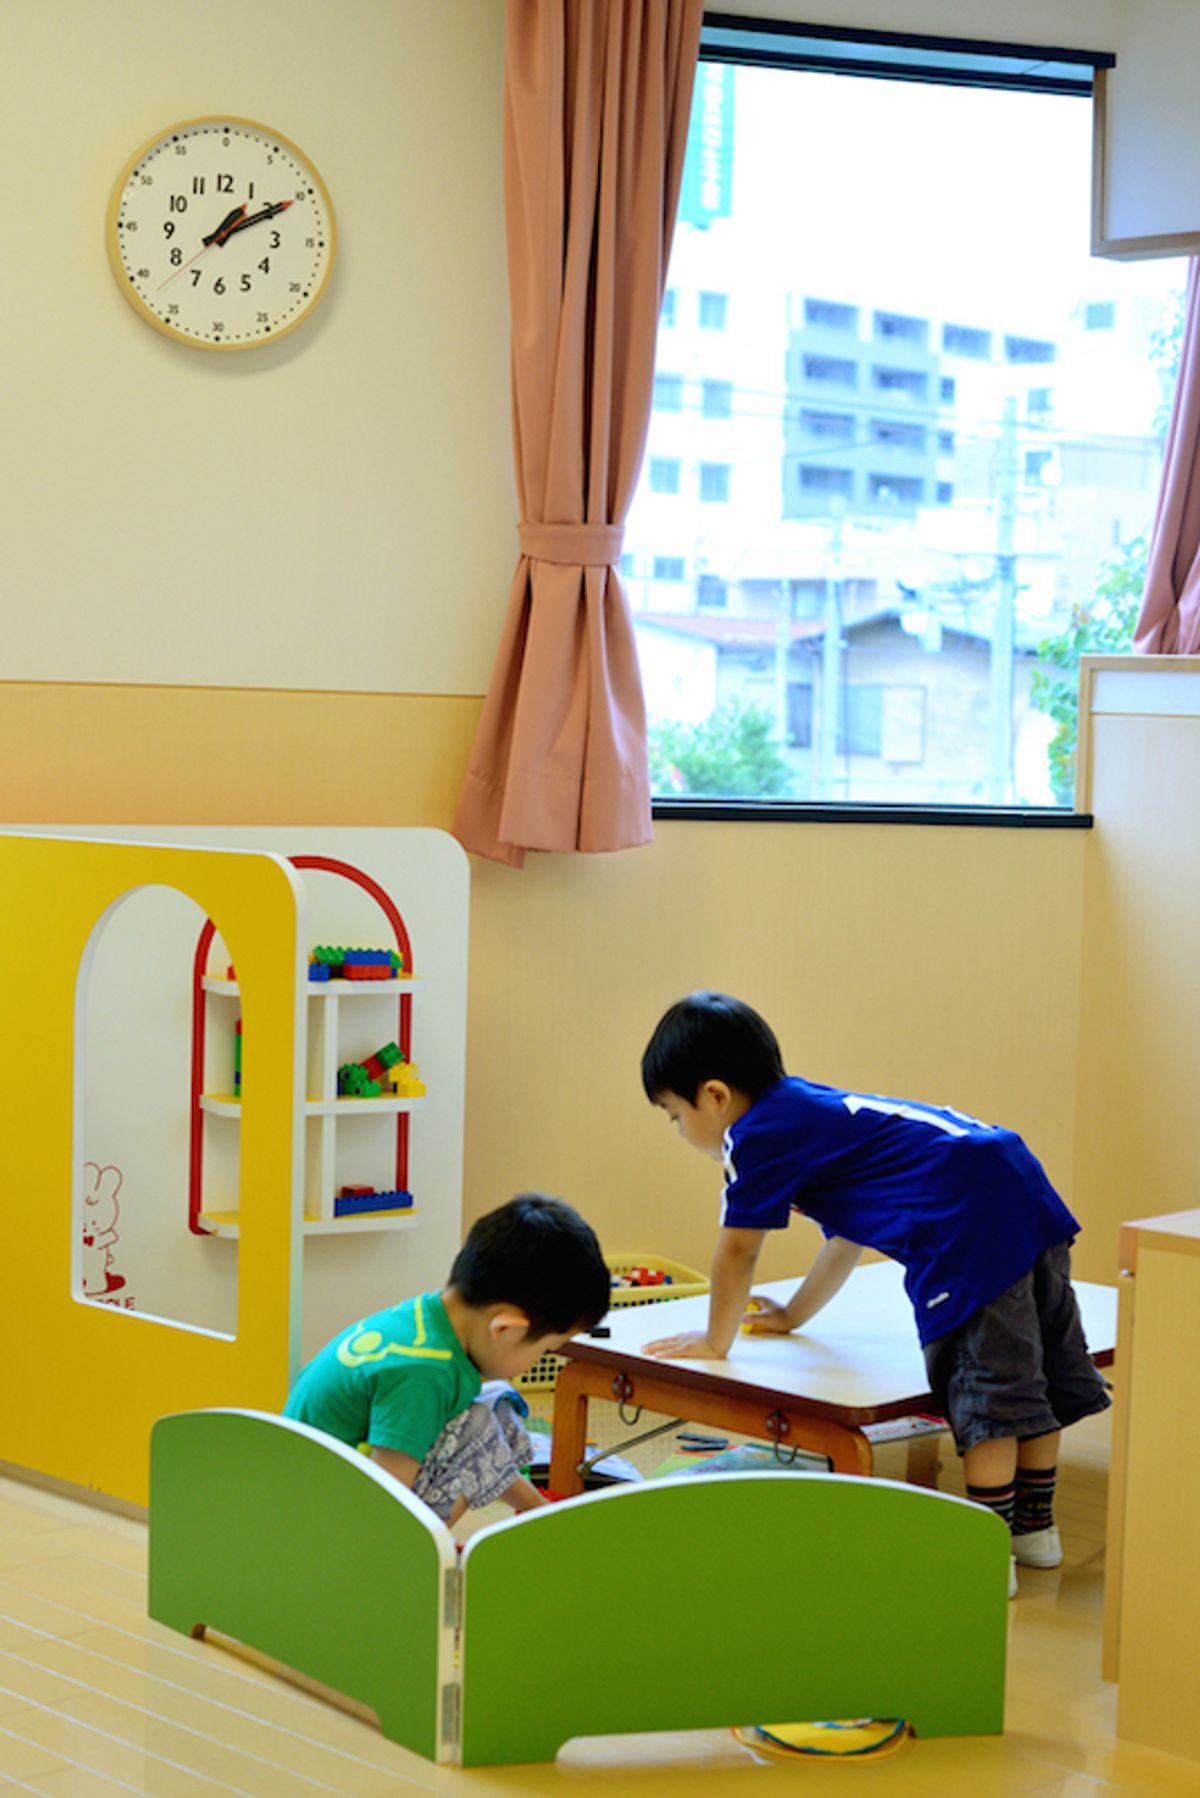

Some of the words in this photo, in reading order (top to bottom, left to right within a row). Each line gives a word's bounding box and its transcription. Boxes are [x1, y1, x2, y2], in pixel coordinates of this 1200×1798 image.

[222, 136, 231, 148] 0
[175, 145, 187, 156] 55
[266, 154, 274, 165] 5
[140, 175, 153, 186] 50
[192, 177, 205, 194] 11
[216, 174, 234, 193] 12
[248, 183, 254, 199] 1
[169, 195, 188, 212] 10
[125, 221, 138, 232] 45
[163, 222, 176, 239] 9
[269, 231, 281, 248] 3
[305, 237, 315, 248] 15
[170, 248, 183, 266] 8
[257, 257, 270, 274] 4
[136, 268, 150, 279] 40
[190, 270, 202, 286] 7
[213, 277, 226, 295] 6
[240, 274, 252, 291] 5
[289, 281, 301, 293] 20
[168, 303, 180, 315] 35
[256, 312, 269, 323] 25
[212, 321, 224, 333] 30
